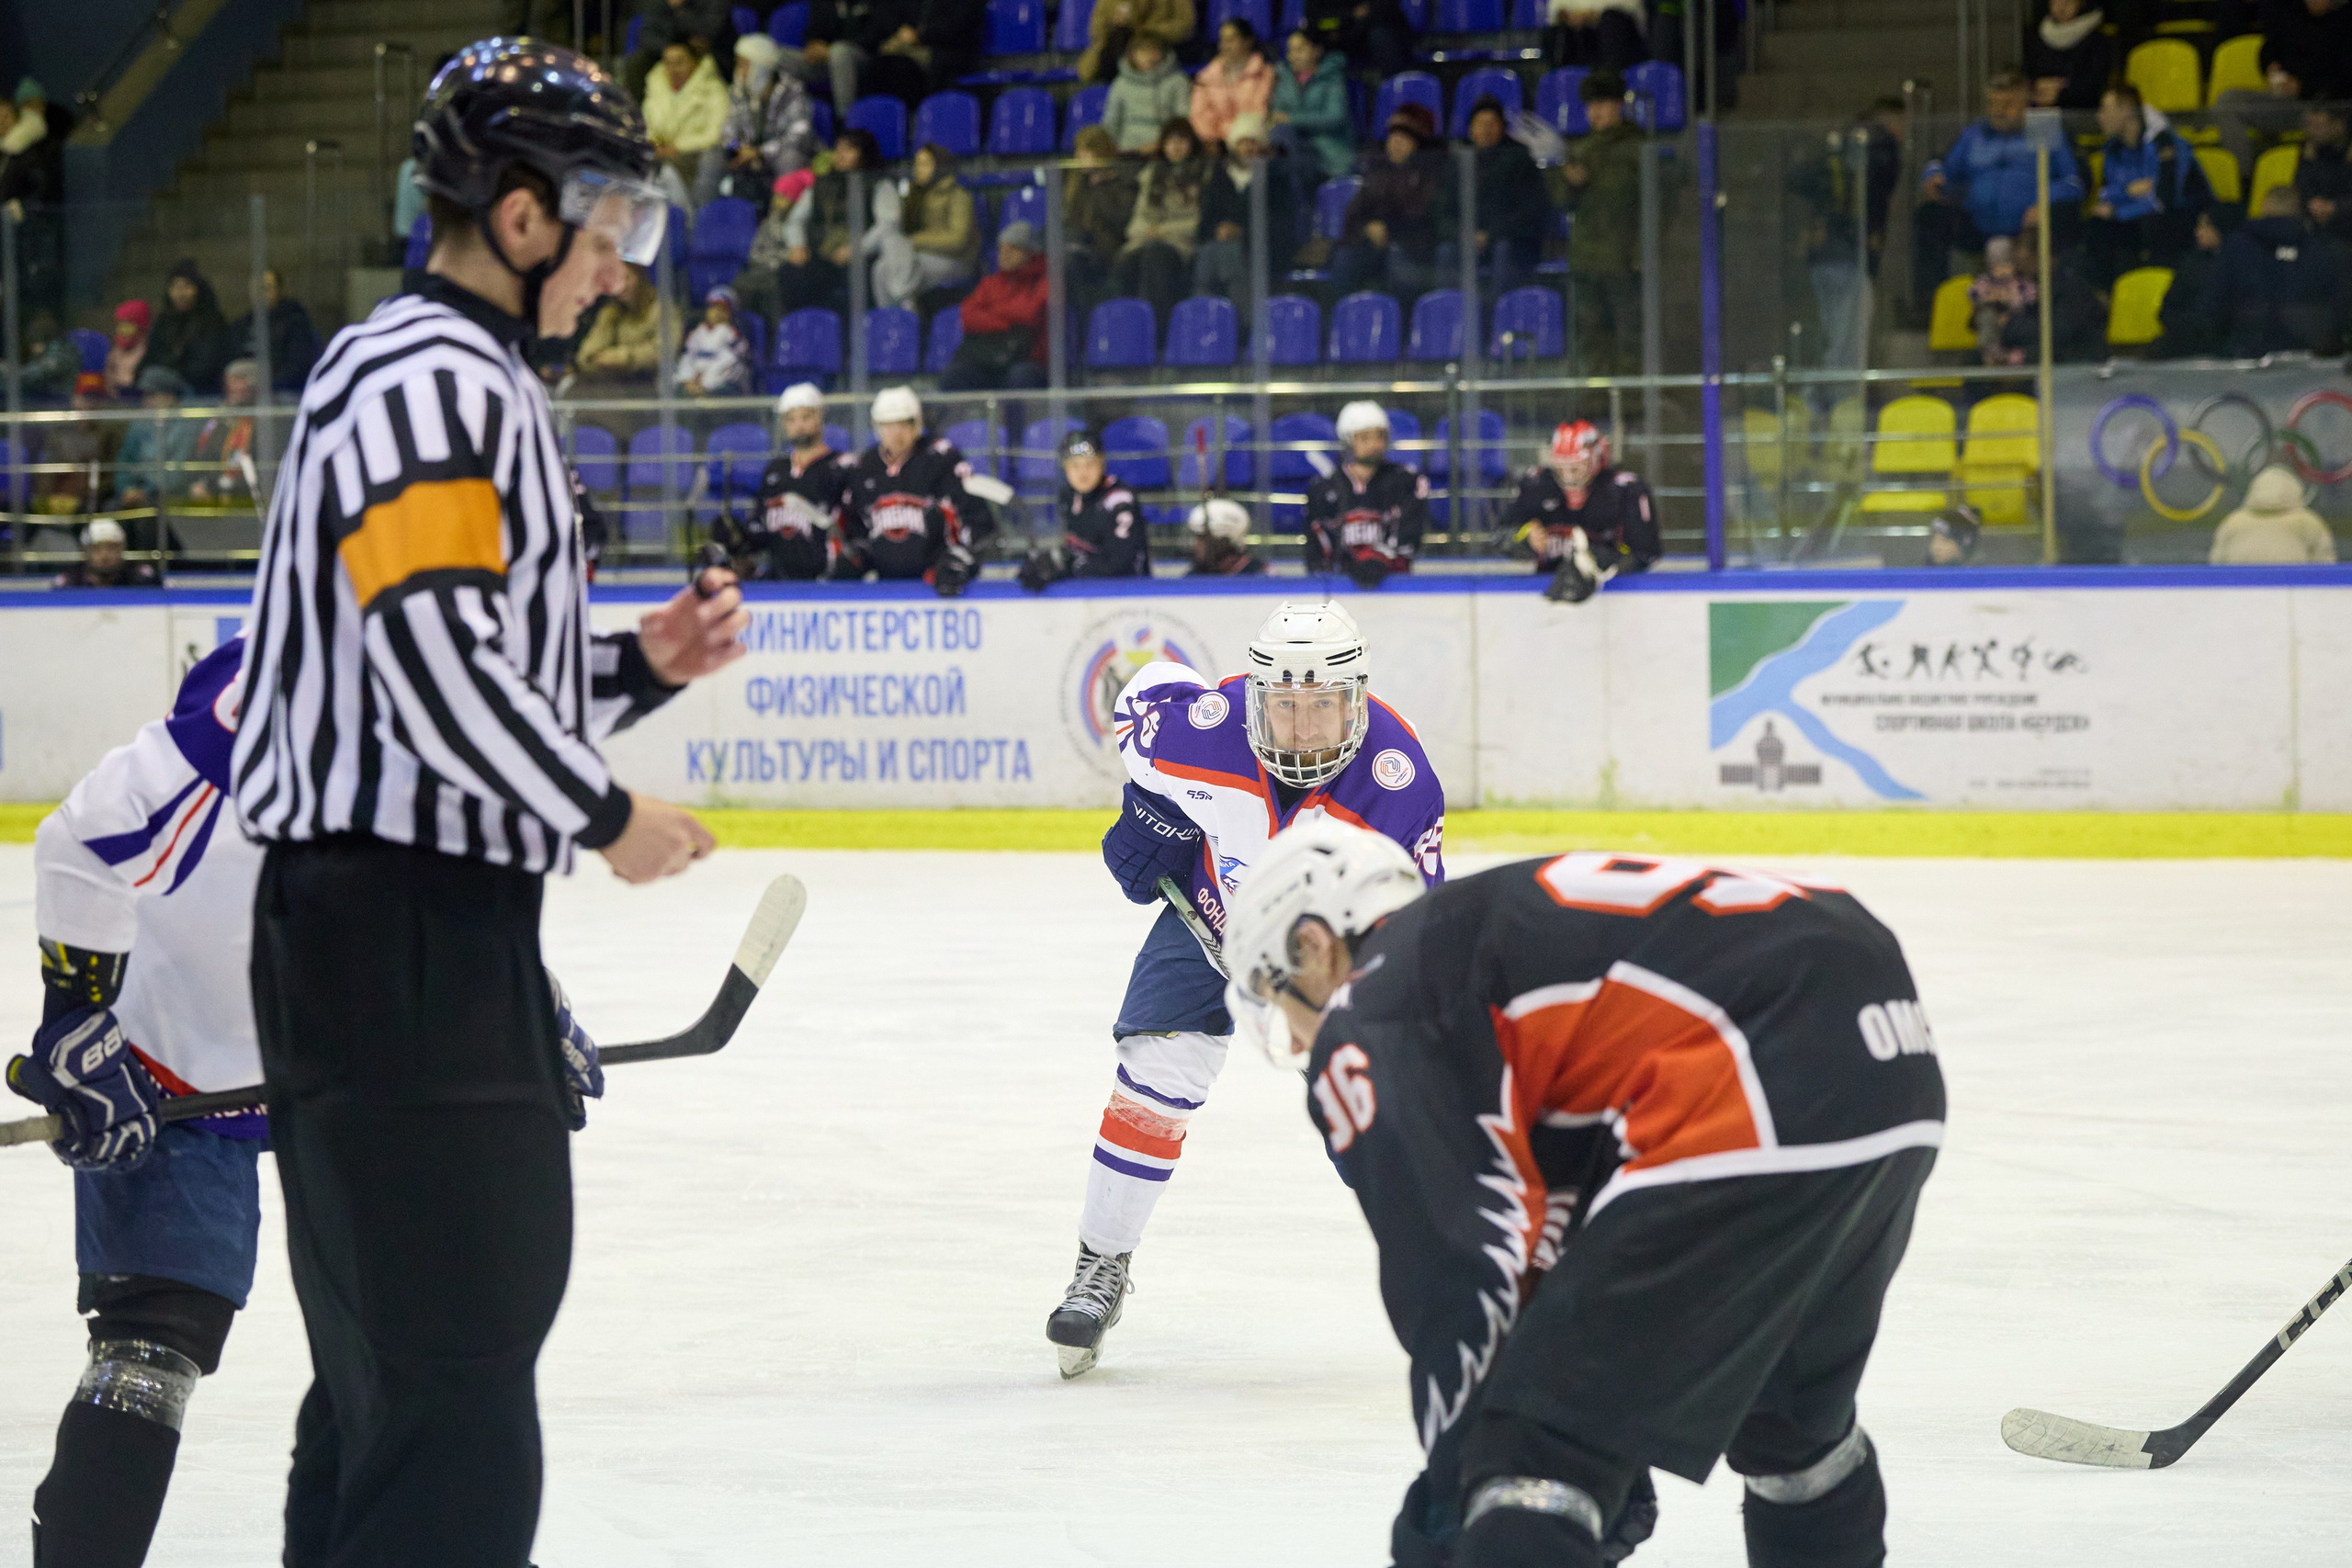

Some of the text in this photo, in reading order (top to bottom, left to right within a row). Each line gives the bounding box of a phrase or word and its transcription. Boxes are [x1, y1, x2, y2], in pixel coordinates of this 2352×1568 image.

[745, 666, 966, 718] ФИЗИЧЕСКОЙ
[685, 738, 1034, 783] КУЛЬТУРЫ И СПОРТА
